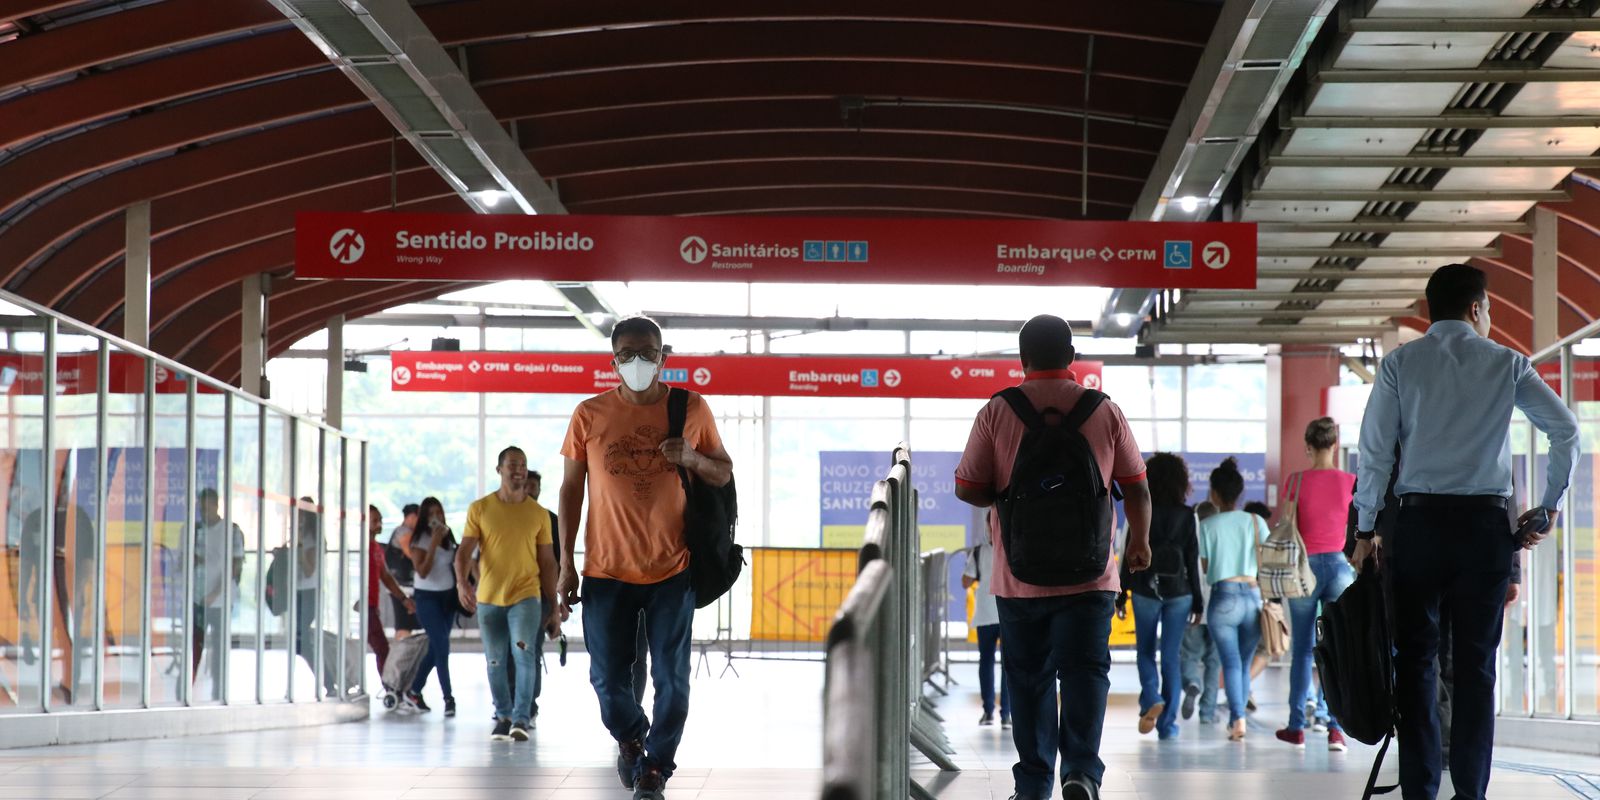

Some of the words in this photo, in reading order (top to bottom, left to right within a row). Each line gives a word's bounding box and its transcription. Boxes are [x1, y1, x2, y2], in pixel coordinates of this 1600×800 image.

[395, 230, 487, 250] Sentido
[494, 231, 594, 251] Proibido
[711, 243, 799, 258] Sanitários
[997, 244, 1096, 263] Embarque
[1117, 249, 1156, 260] CPTM
[396, 255, 423, 264] Wrong
[426, 255, 443, 264] Way
[711, 261, 753, 269] Restrooms
[997, 263, 1045, 274] Boarding
[416, 361, 463, 373] Embarque
[484, 363, 509, 372] CPTM
[513, 363, 545, 373] Grajaú
[552, 364, 584, 373] Osasco
[969, 368, 995, 377] CPTM
[789, 370, 859, 383] Embarque
[823, 464, 870, 478] NOVO
[823, 480, 873, 494] CRUZE
